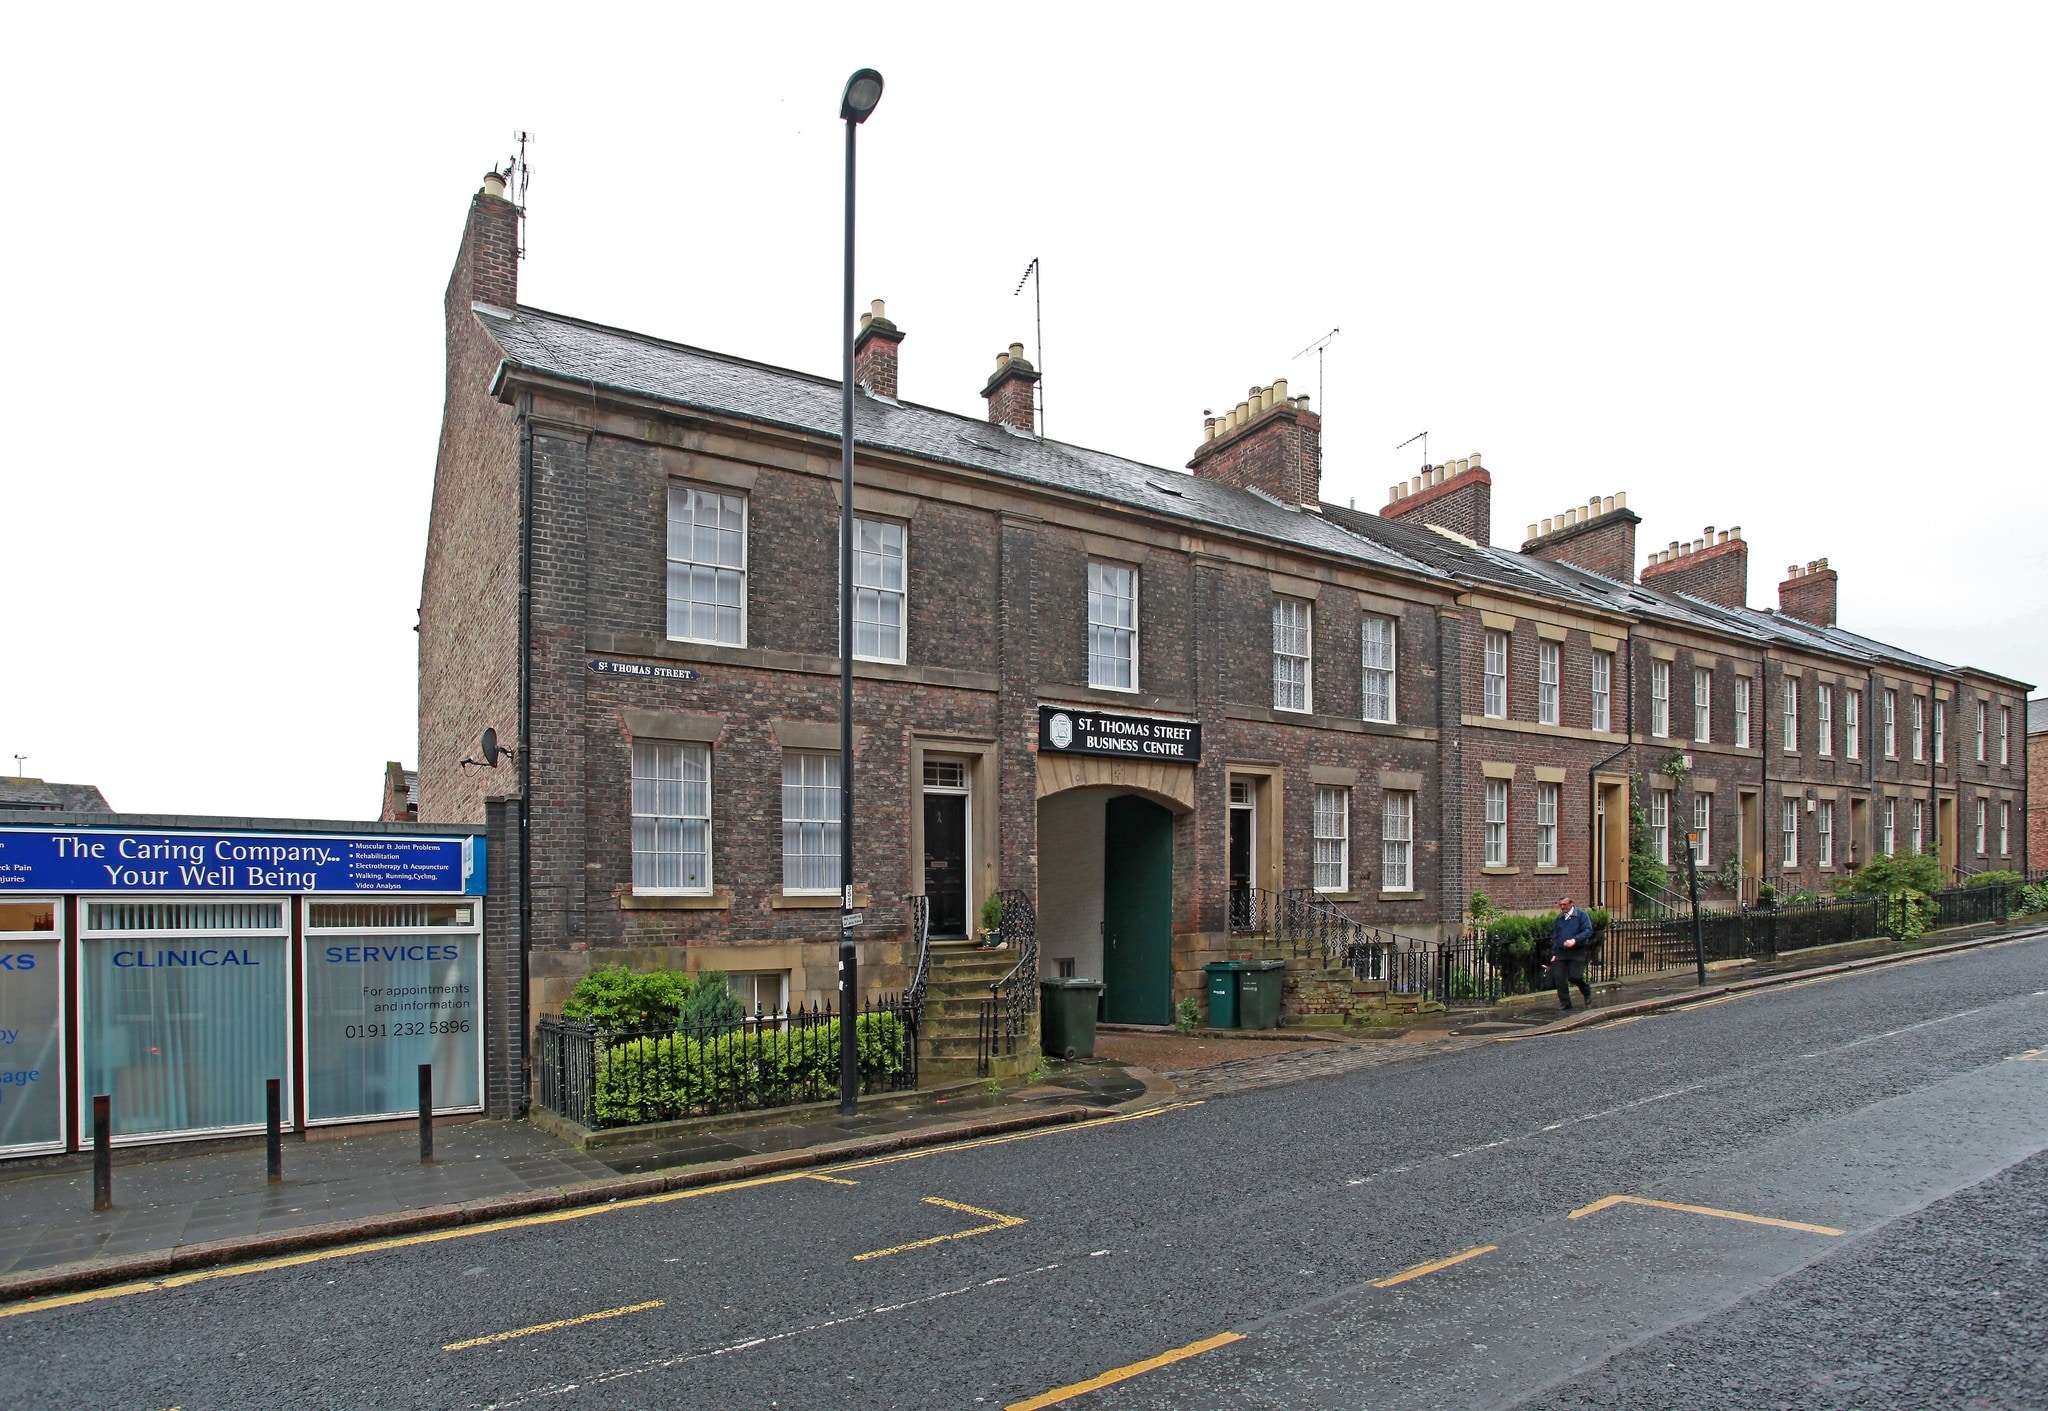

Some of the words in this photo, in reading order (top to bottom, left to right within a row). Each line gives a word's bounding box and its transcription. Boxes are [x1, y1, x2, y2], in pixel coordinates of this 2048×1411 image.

[612, 663, 651, 675] THOMAS
[1078, 718, 1095, 731] ST.
[1099, 719, 1150, 736] THOMAS
[1153, 726, 1192, 741] STREET
[1086, 735, 1139, 752] BUSINESS
[1143, 741, 1184, 756] CENTRE
[52, 837, 106, 859] The
[119, 838, 206, 865] Caring
[355, 863, 401, 871] Electrotherapy
[104, 865, 169, 886] Your
[178, 866, 235, 886] Well
[246, 867, 317, 891] Being
[113, 949, 260, 968] CLINICAL
[325, 945, 459, 963] SERVICES
[363, 986, 384, 997] For
[386, 983, 470, 997] appointments
[374, 1001, 398, 1012] and
[400, 1000, 470, 1011] information
[345, 1023, 388, 1039] 0191
[393, 1021, 425, 1037] 232
[429, 1019, 470, 1035] 5896
